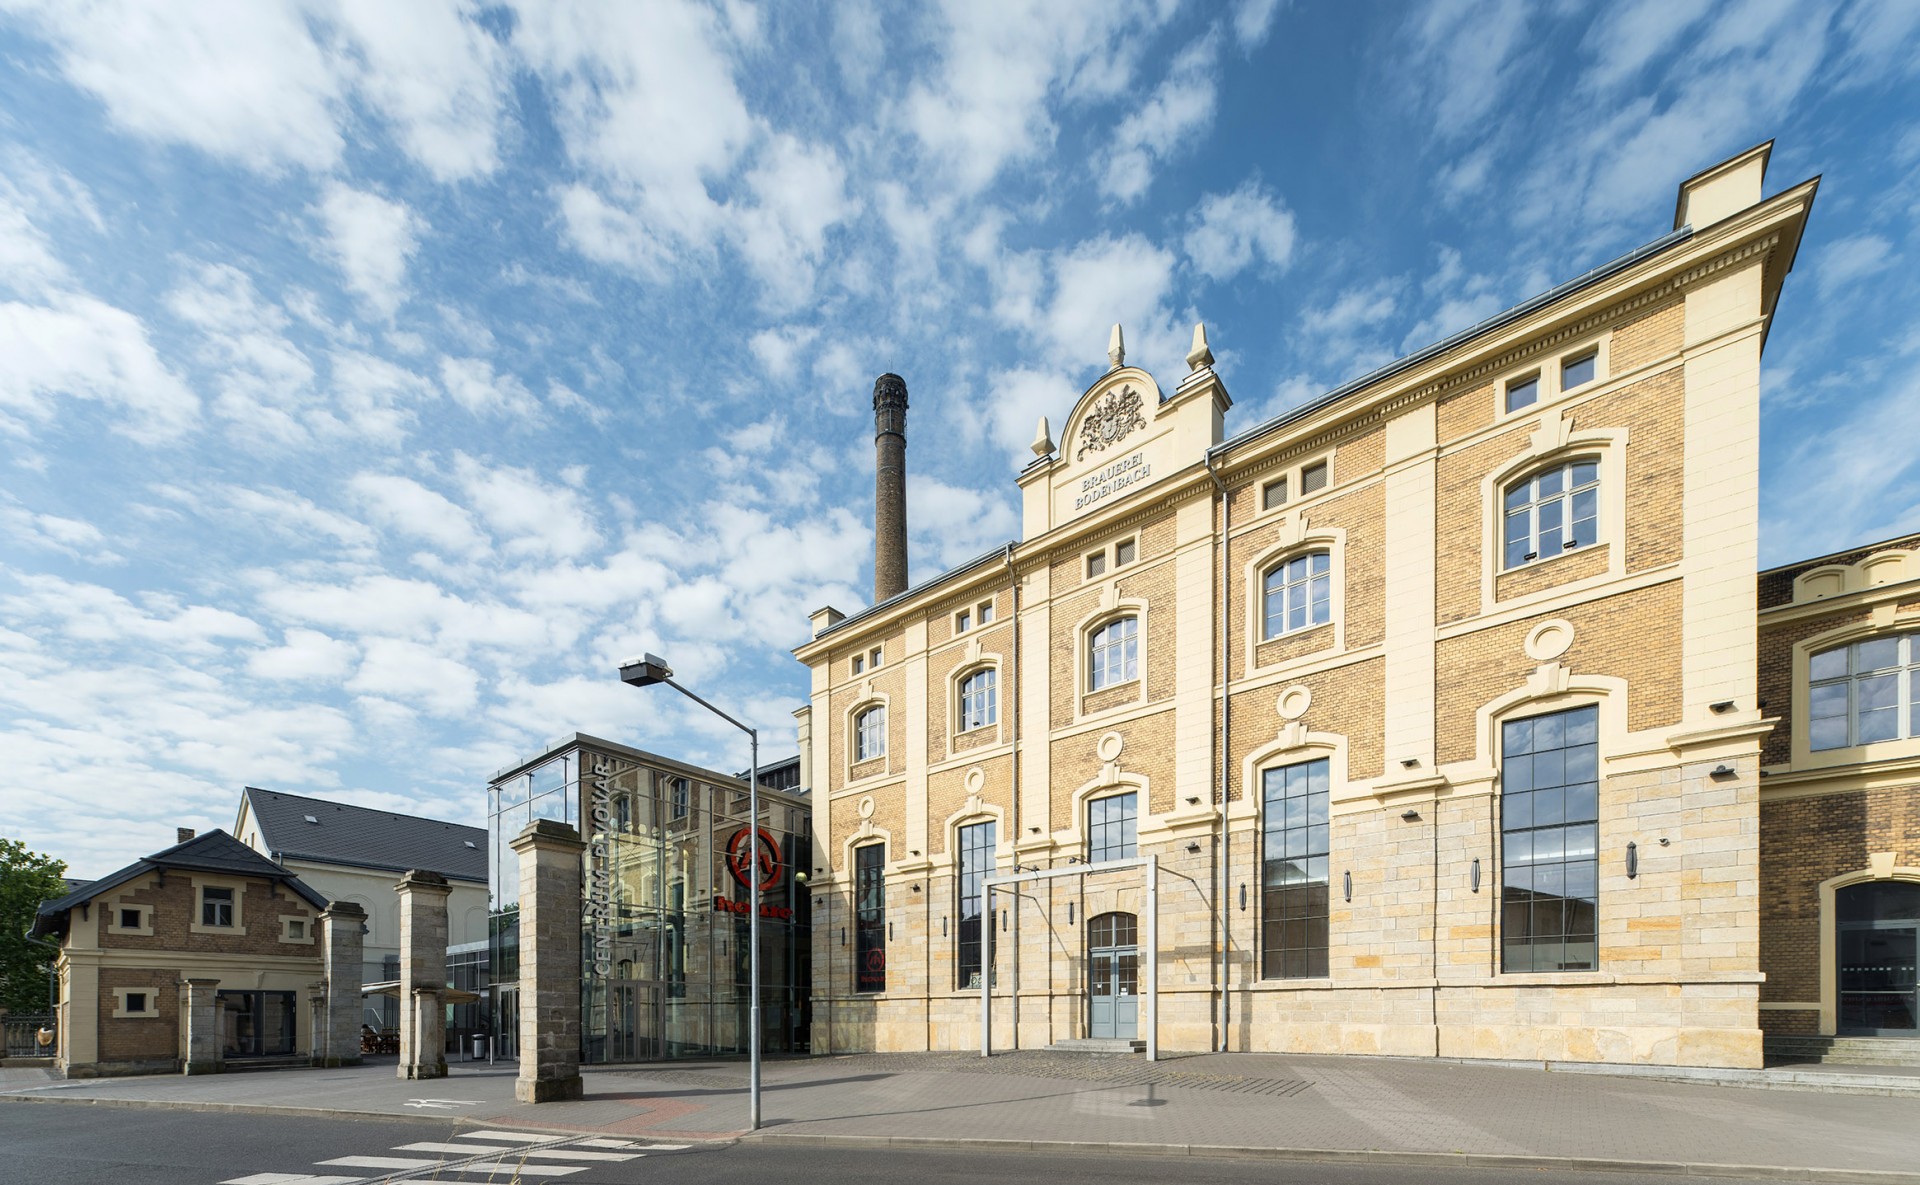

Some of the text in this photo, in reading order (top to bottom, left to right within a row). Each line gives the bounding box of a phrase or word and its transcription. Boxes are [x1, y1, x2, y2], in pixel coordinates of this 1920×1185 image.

[1075, 464, 1151, 511] BODENBACH
[1082, 453, 1143, 493] BRAUEREI
[594, 763, 611, 975] CENTRUM PIVOVAR
